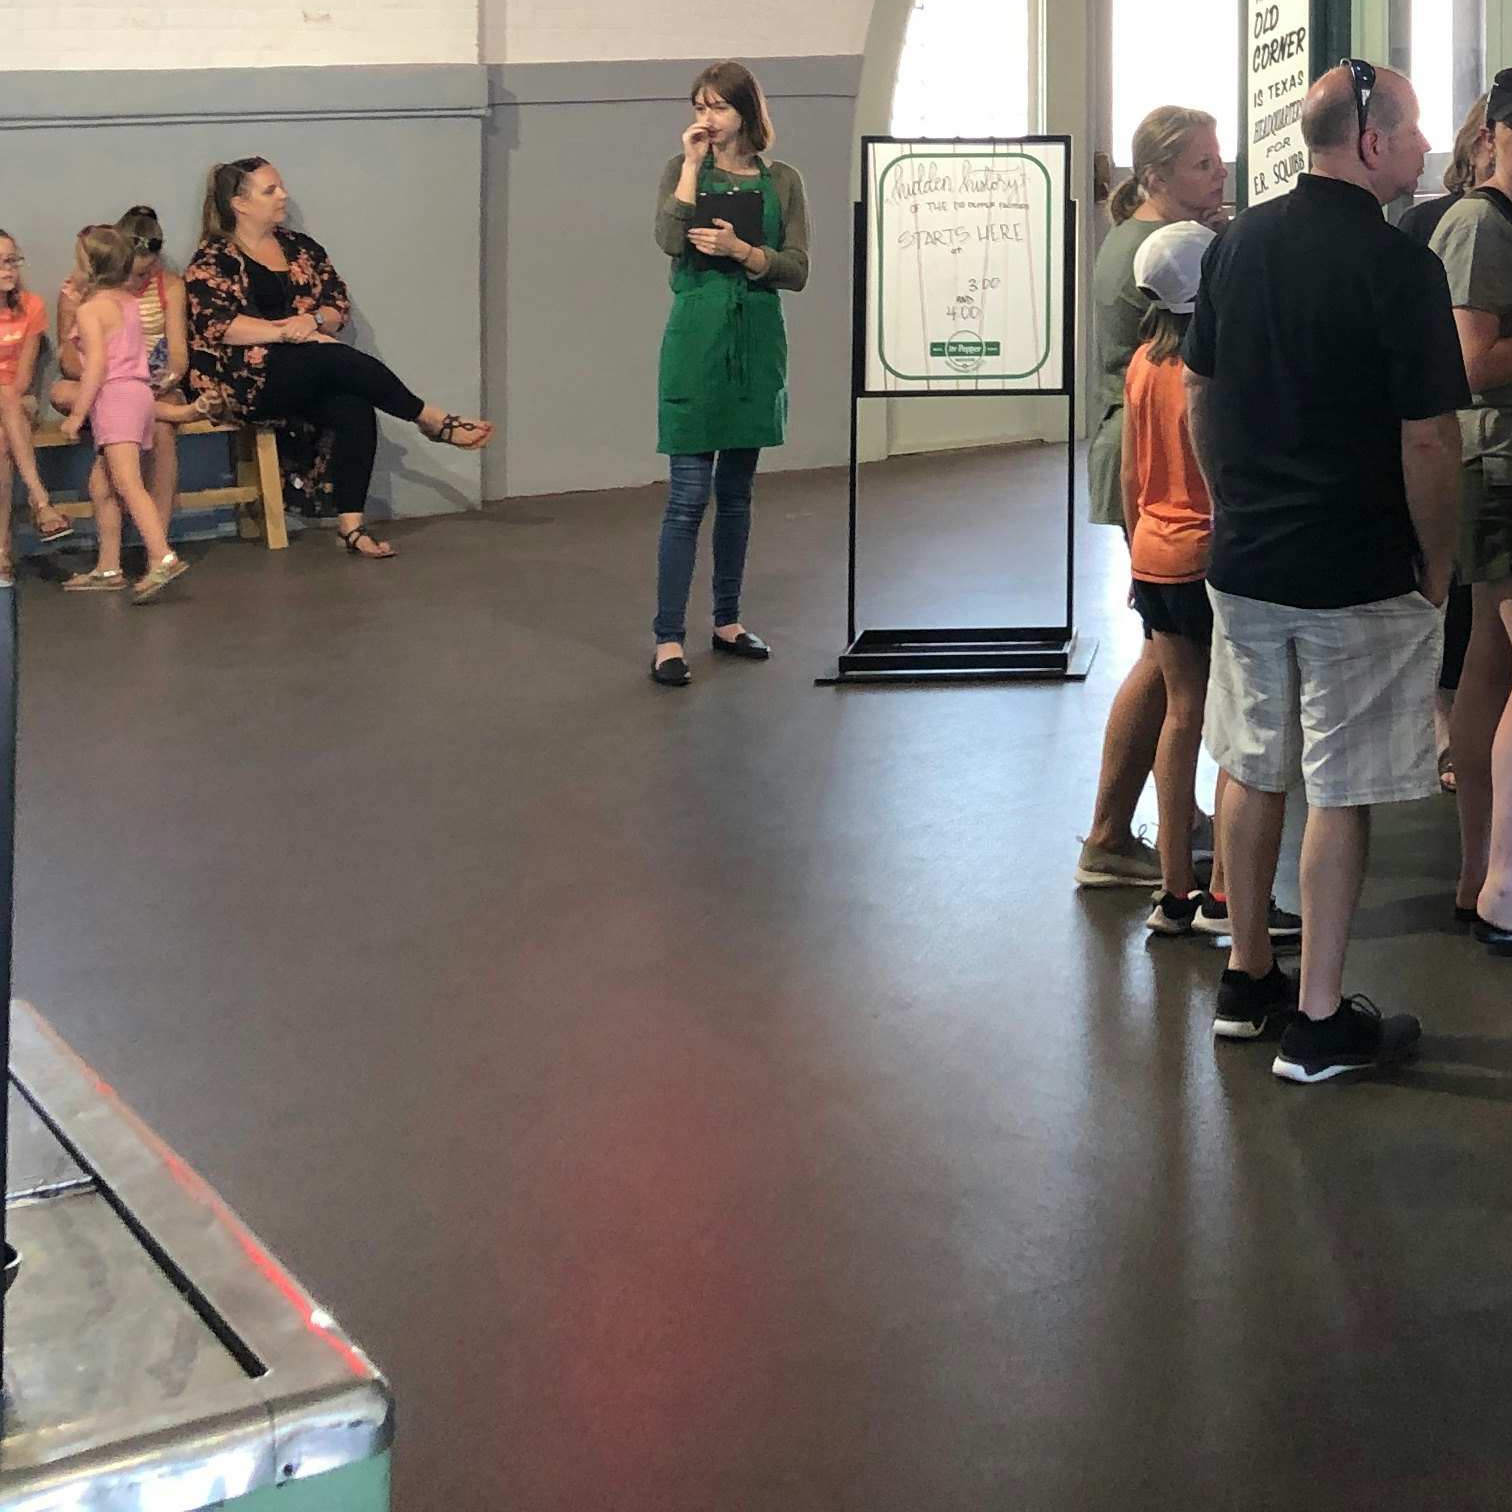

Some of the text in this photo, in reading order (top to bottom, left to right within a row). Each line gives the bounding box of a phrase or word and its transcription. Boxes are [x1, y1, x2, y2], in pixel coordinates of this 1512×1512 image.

[1254, 4, 1279, 39] OLD
[1252, 27, 1306, 73] CORNER
[1253, 70, 1304, 108] IS TEXAS
[1265, 136, 1292, 158] FOR
[1273, 150, 1305, 185] SQUIBB
[898, 223, 1024, 249] STARTS HERE
